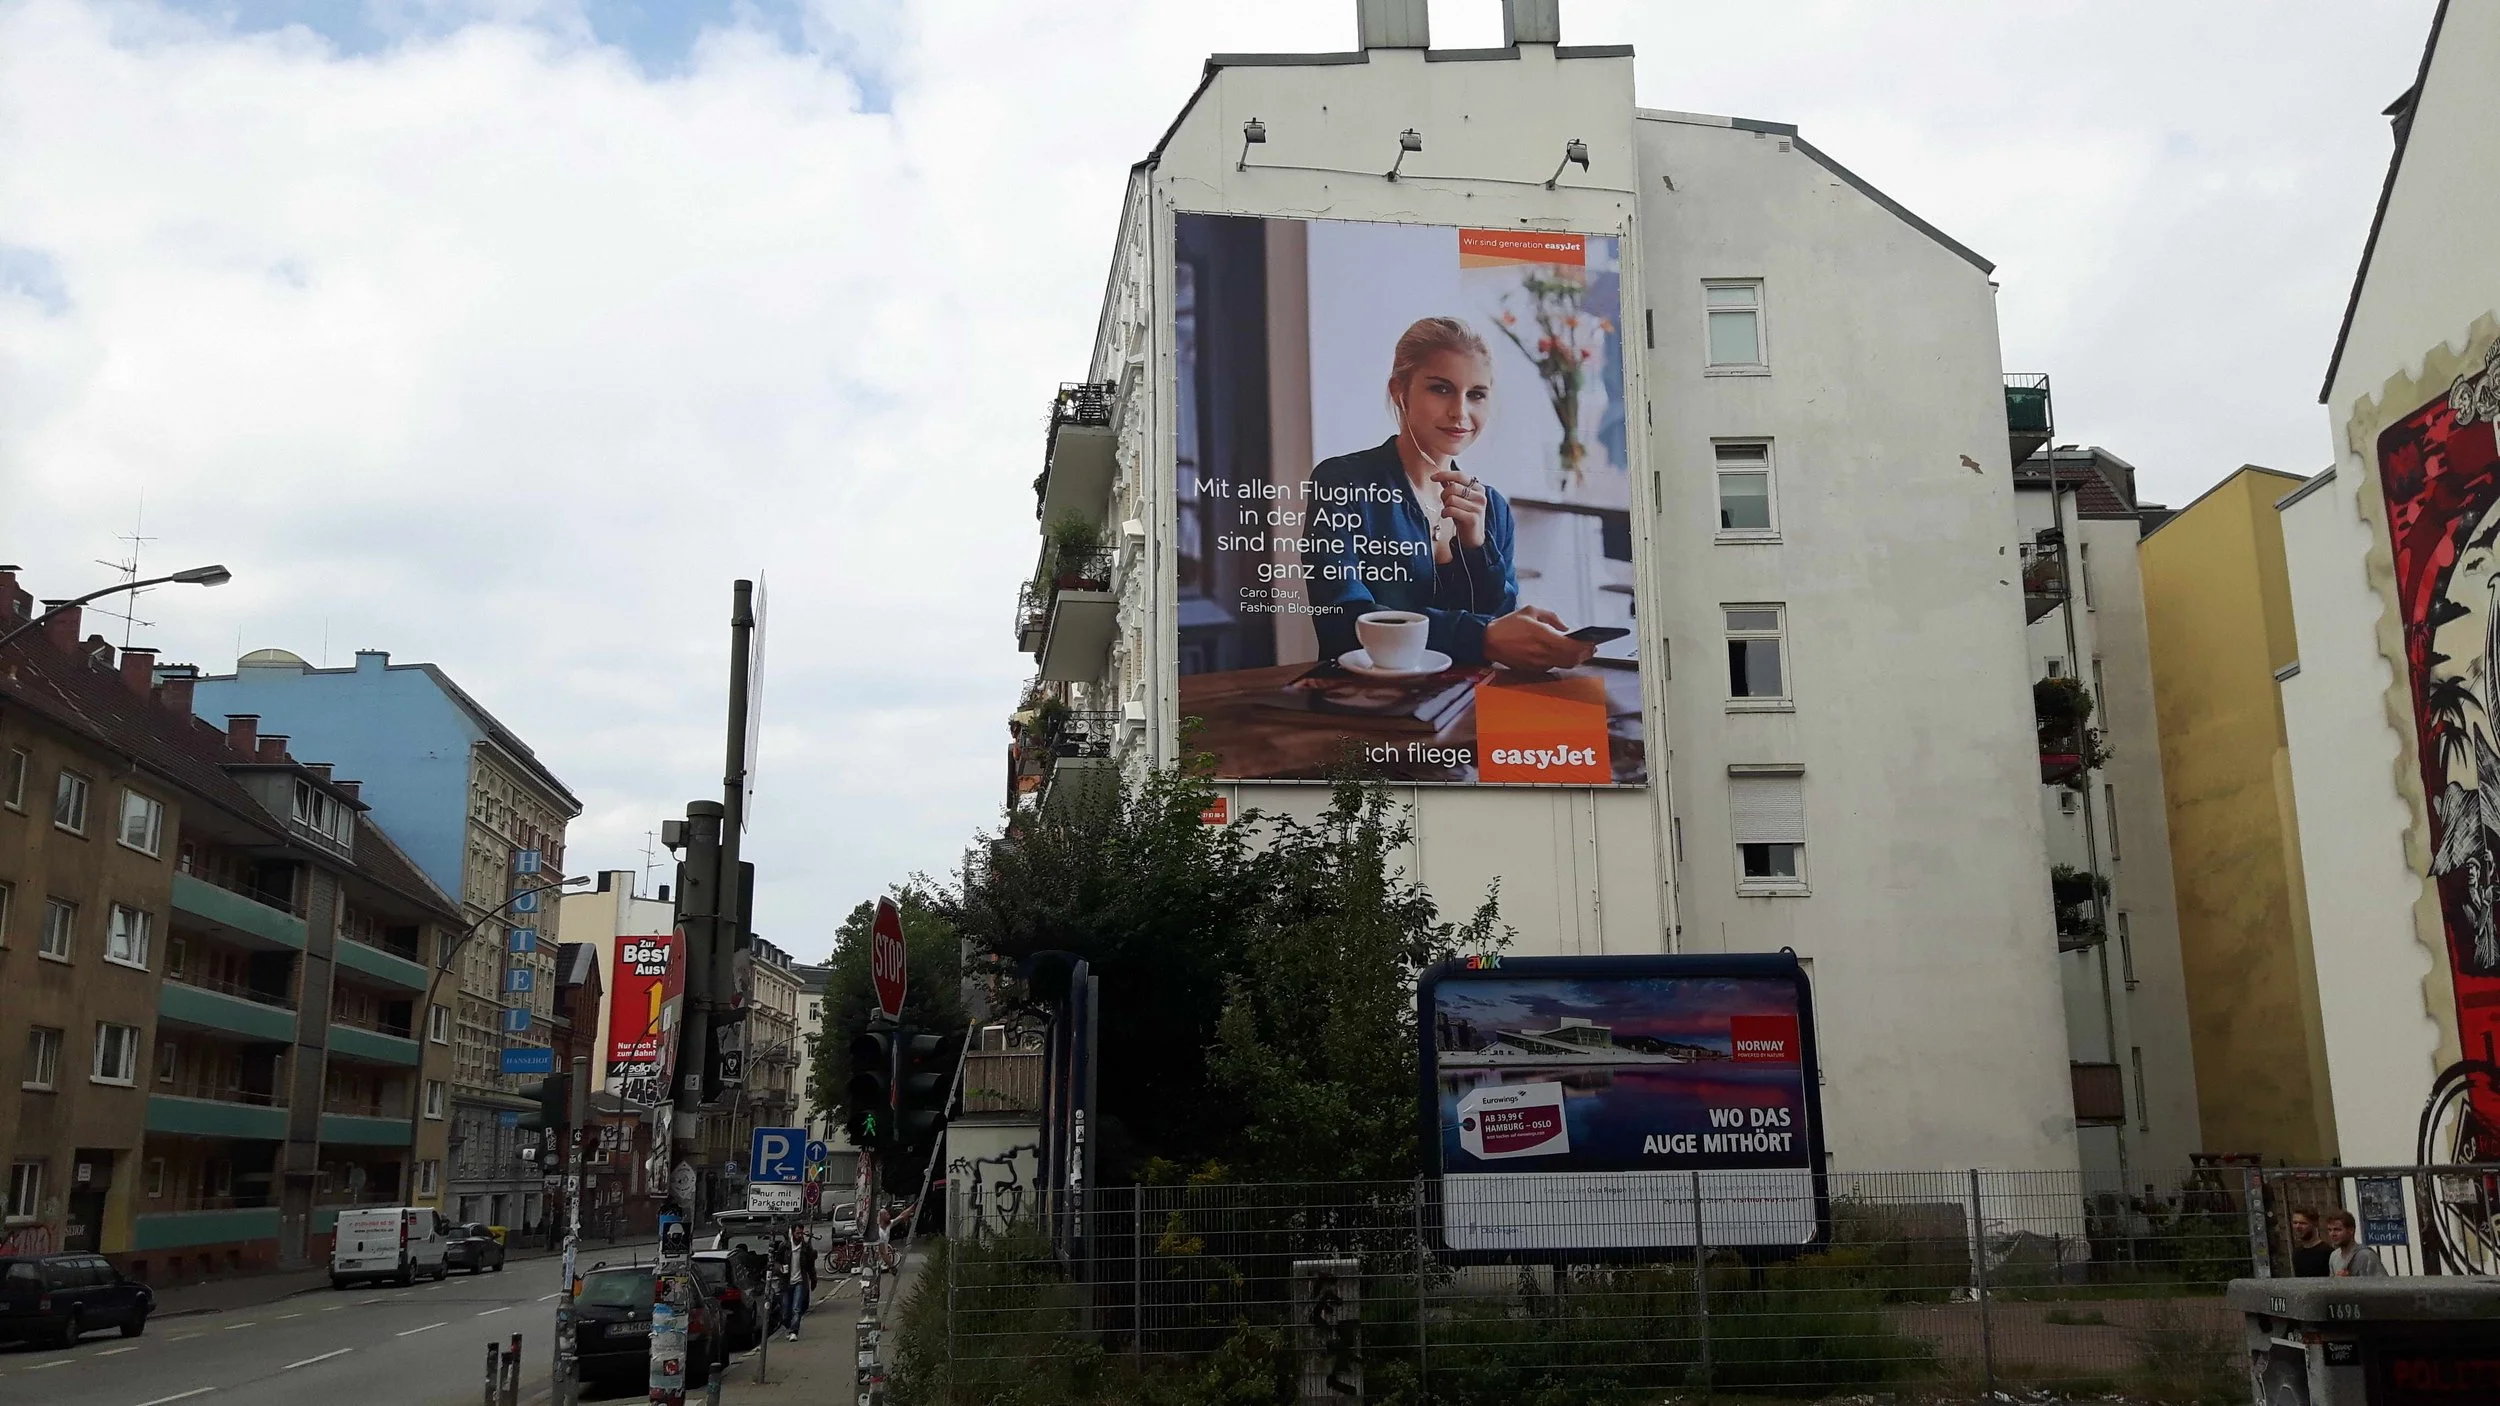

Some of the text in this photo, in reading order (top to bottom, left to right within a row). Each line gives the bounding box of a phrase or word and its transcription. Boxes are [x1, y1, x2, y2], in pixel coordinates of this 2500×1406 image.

[1463, 238, 1581, 251] Wir sind generation easyJet
[1194, 478, 1403, 506] Mit allen Fluginfos
[1239, 505, 1362, 532] in der App
[1217, 531, 1428, 556] sind meine Reisen
[1257, 560, 1413, 582] ganz einfach.
[1239, 587, 1300, 600] Caro Daur,
[1240, 602, 1344, 616] Fashion Bloggerin
[1365, 742, 1597, 770] ich fliege easyJet
[508, 852, 540, 1032] HOTEL
[640, 940, 656, 948] Zur
[875, 932, 903, 984] STOP
[1466, 955, 1501, 969] awk
[1736, 1040, 1784, 1051] NORWAY
[1482, 1095, 1519, 1105] Eurowings
[1485, 1114, 1496, 1123] AB
[1497, 1112, 1517, 1122] 39,99
[1708, 1107, 1791, 1128] WO DAS
[1485, 1122, 1524, 1133] HAMBURG
[1532, 1119, 1552, 1129] OSLO
[1643, 1128, 1792, 1154] AUGE MITHÖRT
[759, 1134, 790, 1175] P
[778, 1190, 792, 1198] mit
[752, 1198, 798, 1207] Parkschein
[2328, 1304, 2361, 1319] 1696
